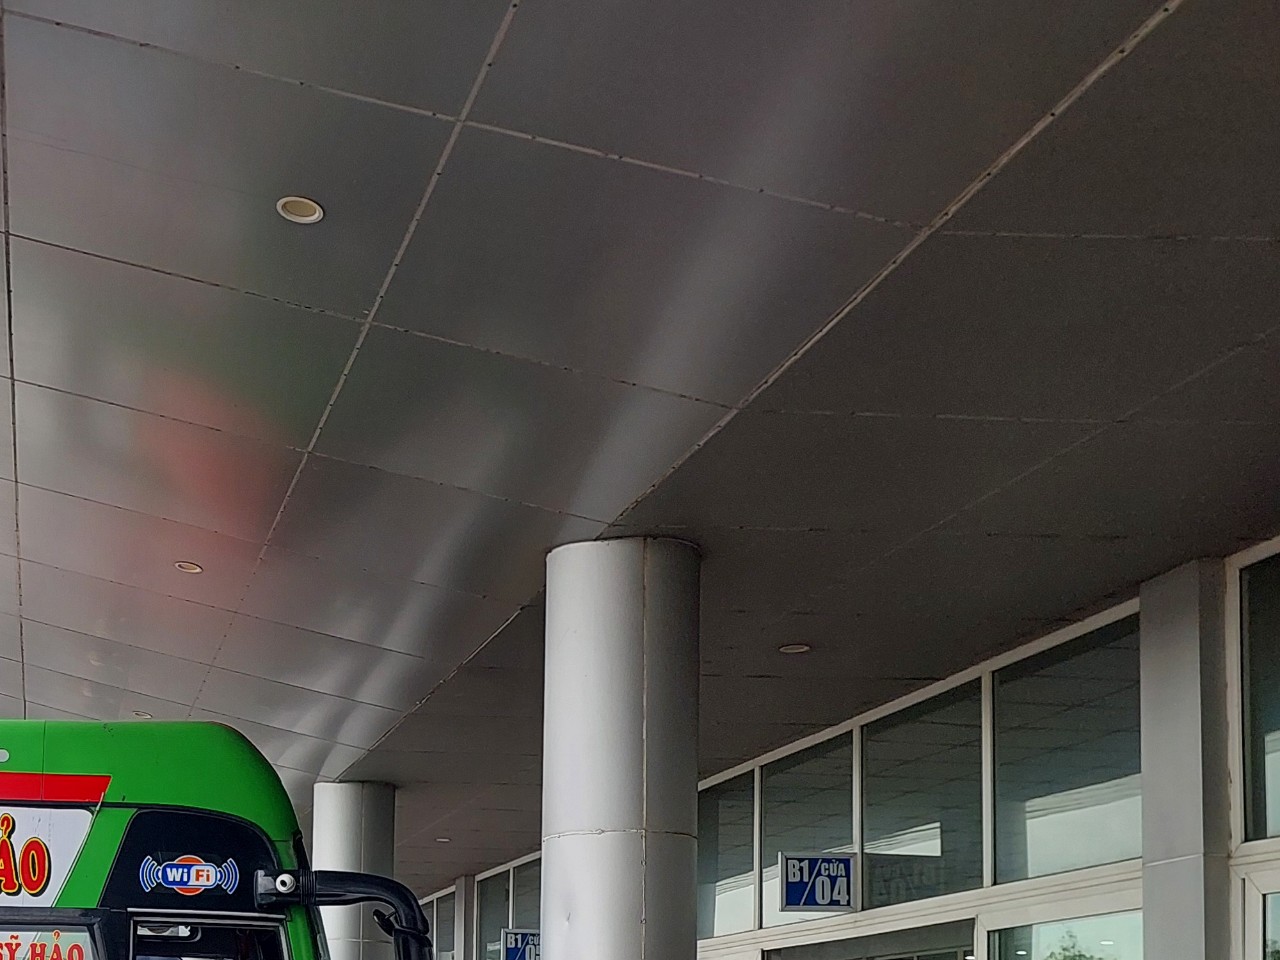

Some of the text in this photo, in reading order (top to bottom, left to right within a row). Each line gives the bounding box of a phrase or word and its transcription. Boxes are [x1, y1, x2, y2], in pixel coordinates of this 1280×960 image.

[788, 859, 809, 882] B1
[821, 859, 846, 876] CỬA
[815, 876, 849, 905] 04
[507, 934, 521, 948] B1
